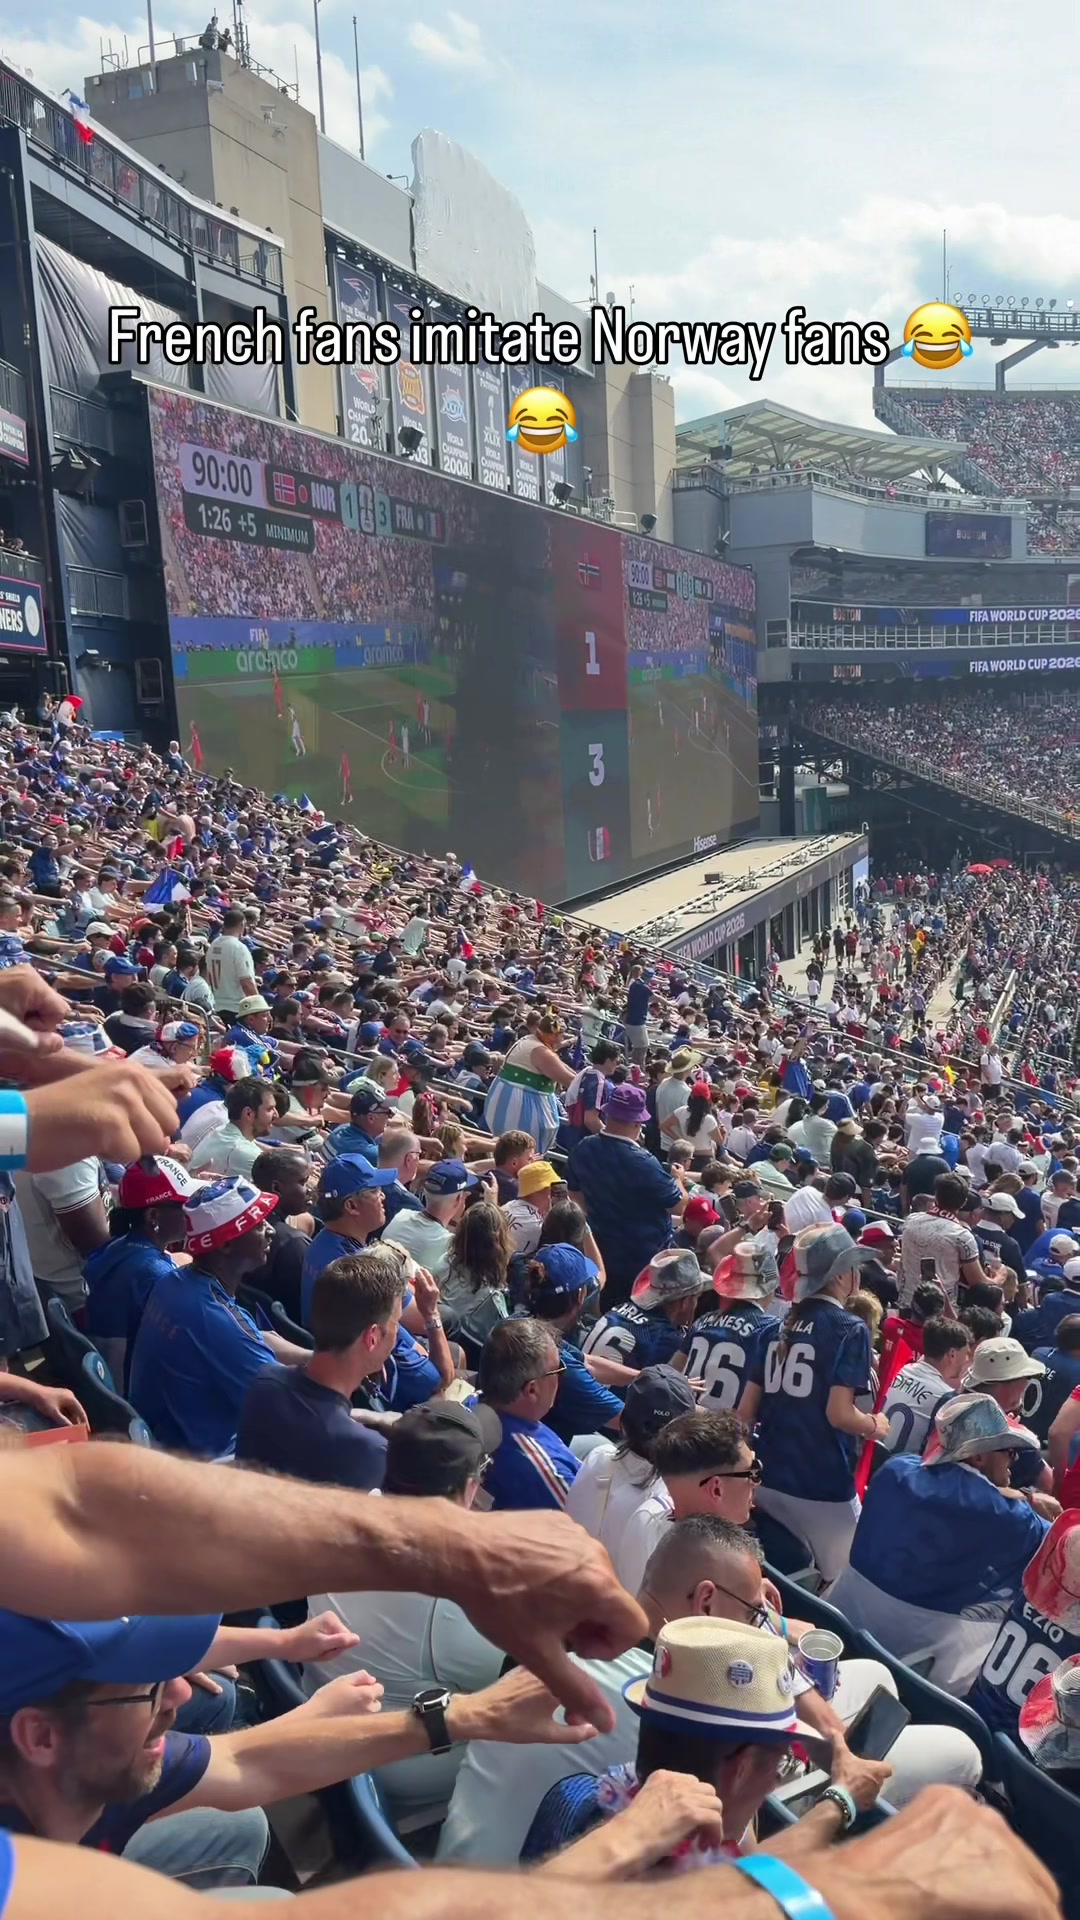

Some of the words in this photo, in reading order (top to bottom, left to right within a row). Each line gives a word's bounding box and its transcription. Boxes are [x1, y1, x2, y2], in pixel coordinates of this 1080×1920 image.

[353, 397, 375, 414] WORLD
[446, 431, 464, 447] WORLD
[192, 451, 252, 497] 90:00
[443, 455, 469, 477] 2004
[483, 469, 504, 490] 2014
[518, 481, 537, 501] 2016
[311, 482, 336, 513] NOR
[379, 507, 387, 529] 3
[395, 504, 415, 530] FRA
[198, 503, 232, 537] 1:26
[238, 514, 257, 537] +5
[265, 523, 309, 544] MINIMUM
[970, 610, 989, 622] FIFA
[990, 609, 1026, 622] WORLD
[1028, 609, 1048, 621] CUP
[585, 631, 600, 675] 1
[970, 661, 989, 673] FIFA
[990, 660, 1026, 672] WORLD
[1028, 658, 1048, 671] CUP
[589, 743, 605, 787] 3
[693, 834, 717, 851] Hisense
[691, 930, 714, 959] WORLD
[714, 924, 727, 945] CUP
[726, 912, 746, 938] 2026
[157, 1157, 188, 1187] FRANCE
[146, 1190, 173, 1204] FRANCE
[683, 1336, 746, 1410] 06
[764, 1341, 815, 1398] 06
[653, 1409, 670, 1417] POLO
[982, 1619, 1062, 1708] 06
